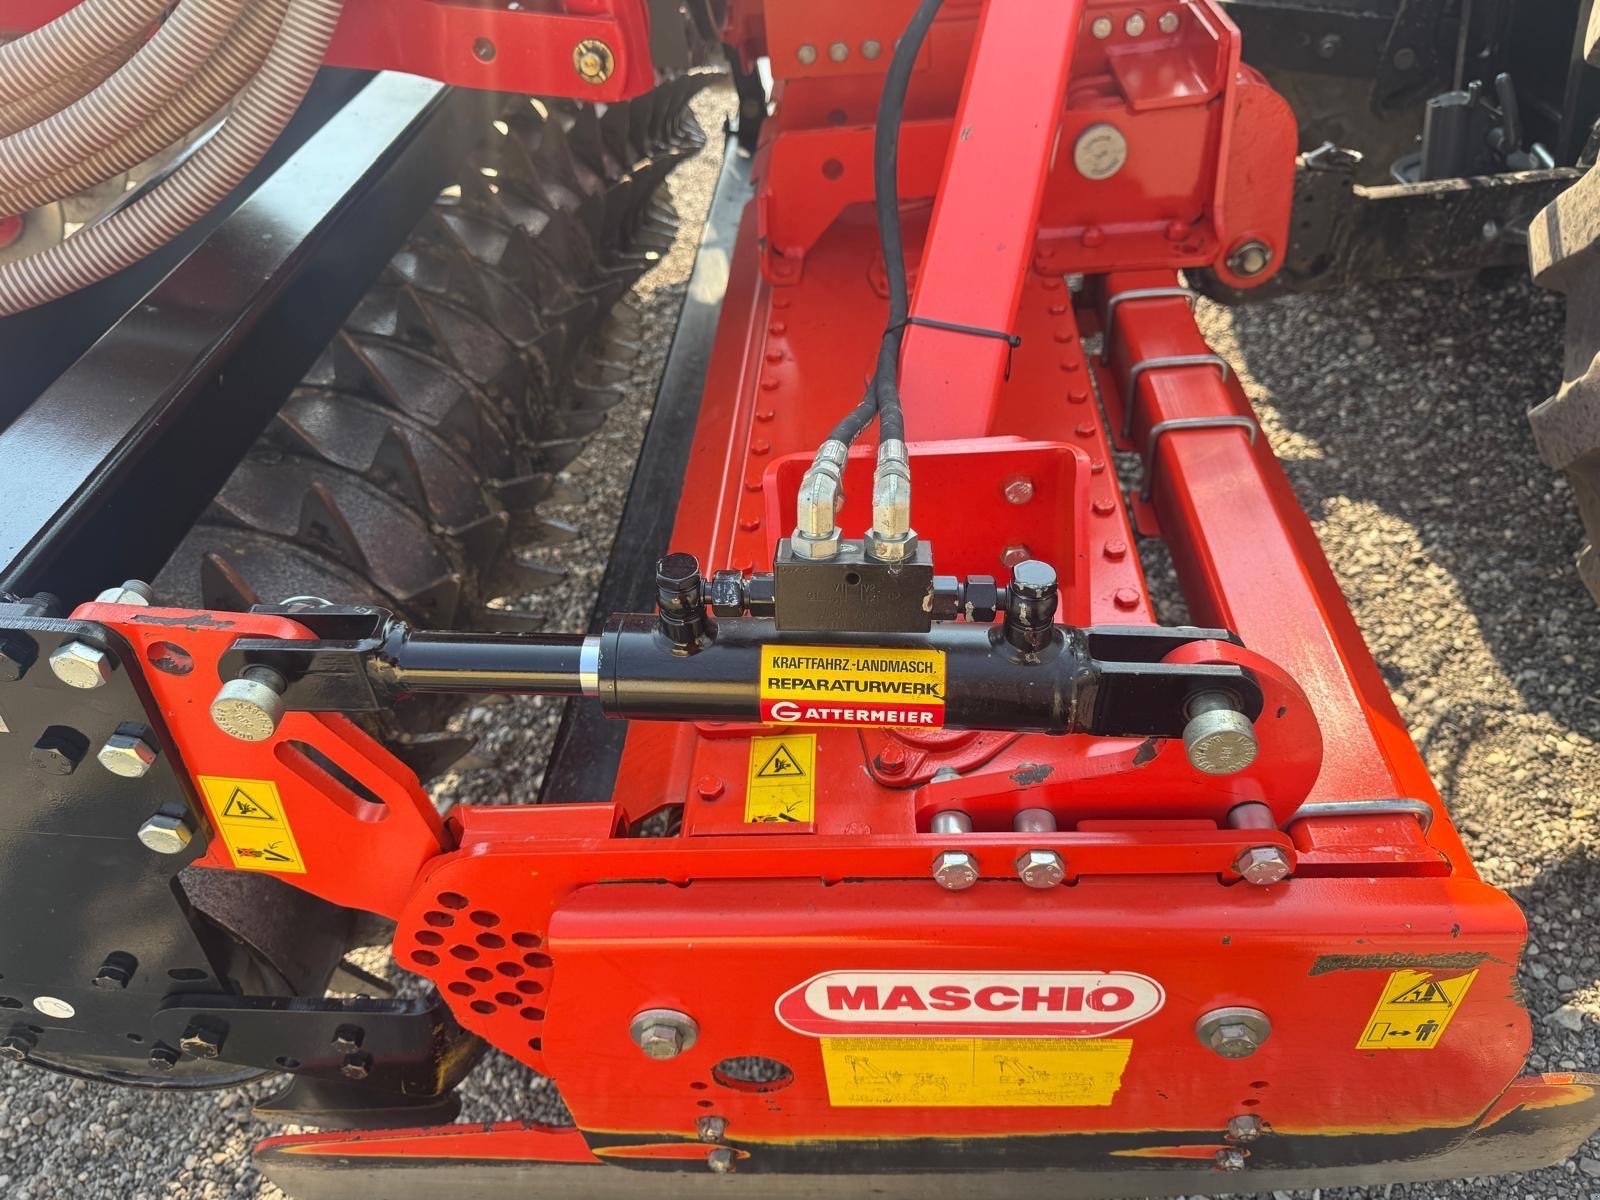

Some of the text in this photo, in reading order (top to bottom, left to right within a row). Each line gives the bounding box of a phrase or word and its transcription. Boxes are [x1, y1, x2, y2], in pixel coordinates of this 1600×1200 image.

[772, 656, 937, 674] KRAFTFAHRZ.-LANDMASCH.
[767, 677, 940, 696] REPARATURWERK
[770, 701, 934, 723] GATTERMEIER
[826, 985, 1135, 1012] MASCHIO
